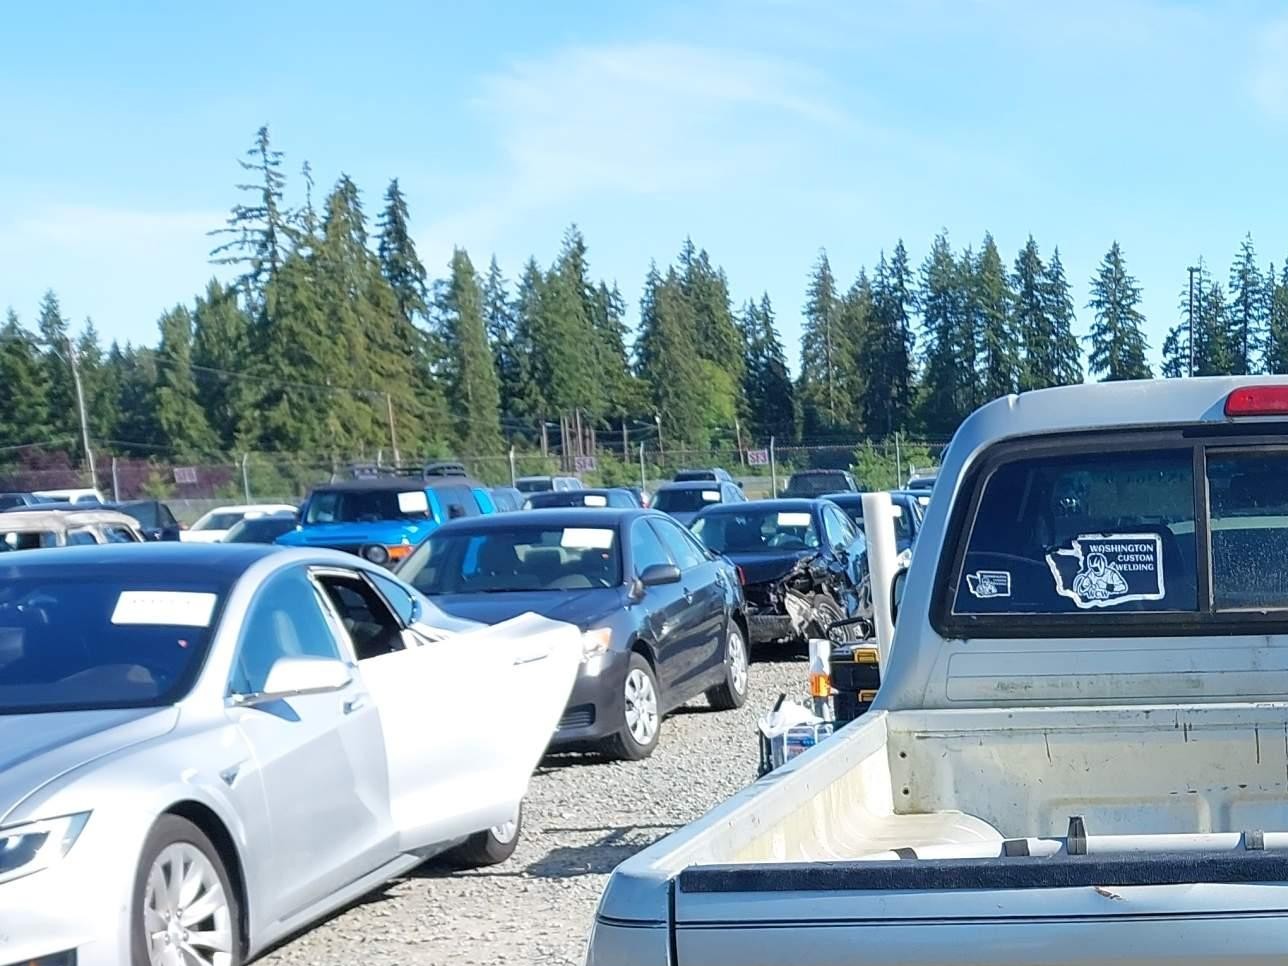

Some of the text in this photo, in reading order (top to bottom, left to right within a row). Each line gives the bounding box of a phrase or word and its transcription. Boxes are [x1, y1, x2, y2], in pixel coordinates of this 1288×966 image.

[1089, 544, 1154, 553] WASHINGTON
[1117, 554, 1154, 562] CUSTOM
[1115, 563, 1155, 571] WELDING
[1087, 590, 1109, 599] WCW
